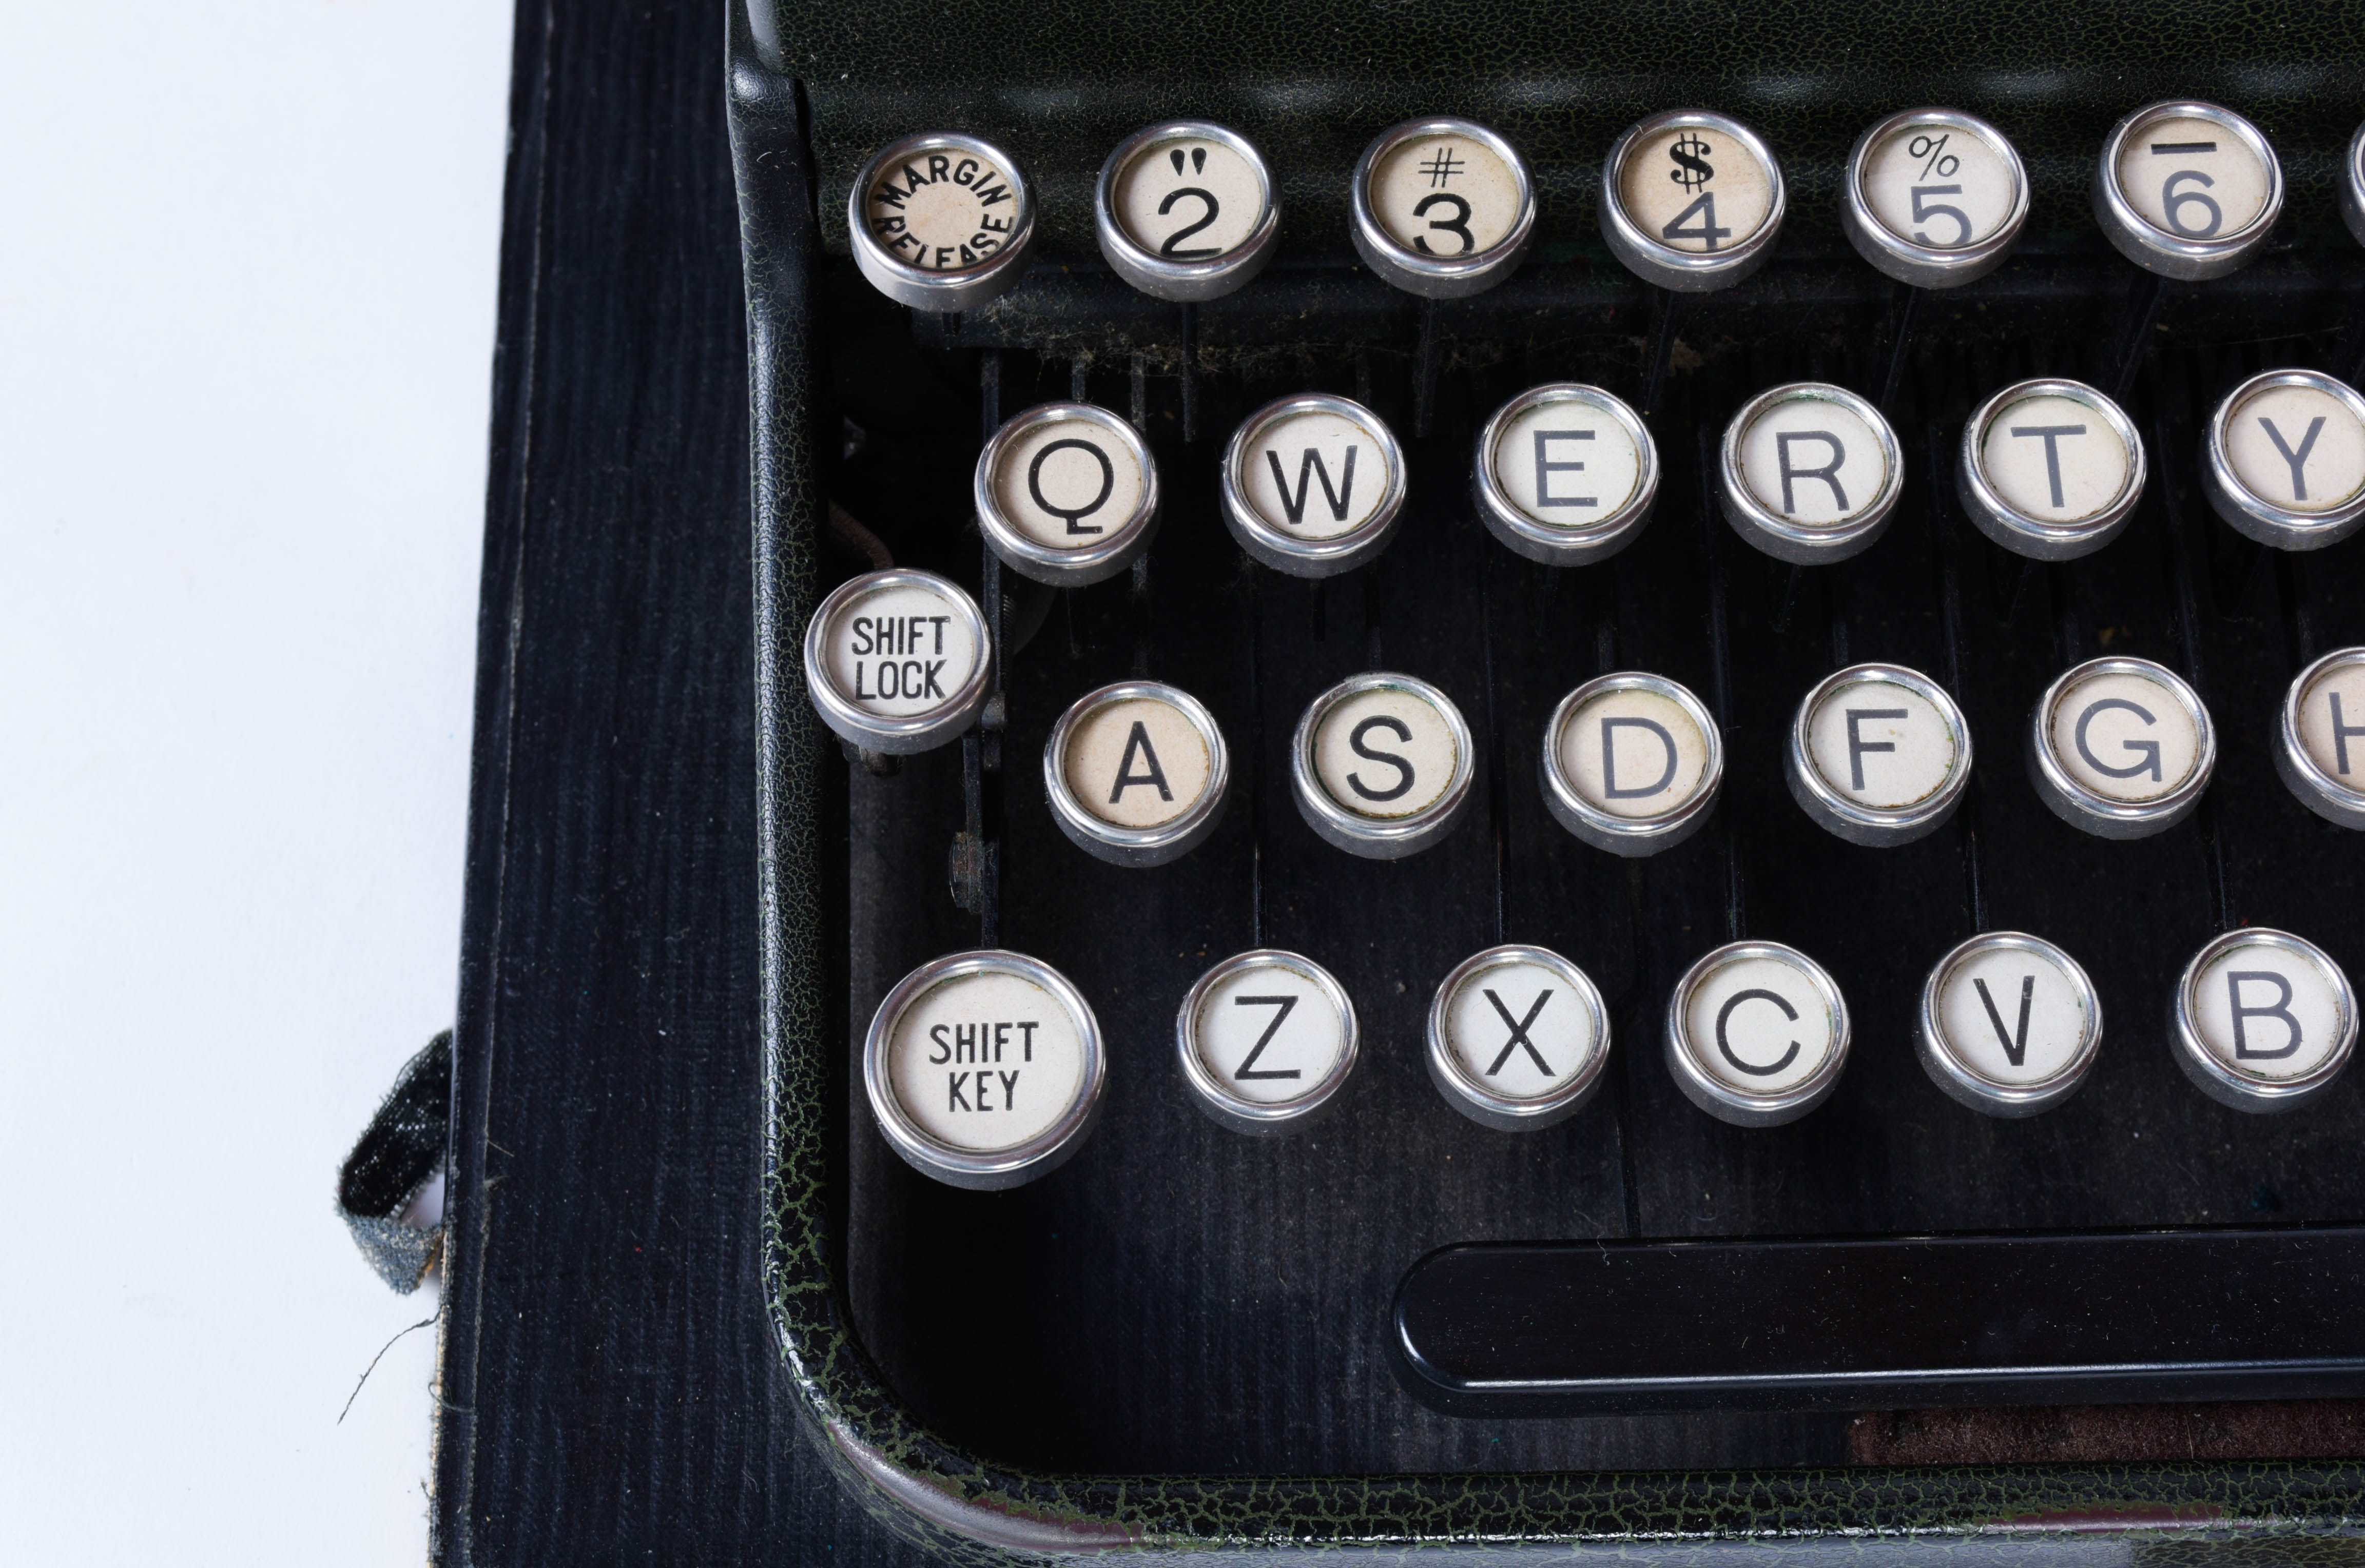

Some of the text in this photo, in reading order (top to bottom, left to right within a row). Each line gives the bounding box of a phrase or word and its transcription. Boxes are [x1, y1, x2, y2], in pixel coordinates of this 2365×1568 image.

[876, 155, 1011, 209] MARGIN
[1419, 148, 1465, 188] #
[1670, 133, 1714, 193] $
[1909, 134, 1960, 181] %
[1158, 188, 1222, 257] 2
[1413, 193, 1474, 254] 3
[1662, 191, 1732, 249] 4
[1910, 185, 1972, 246] 5
[2161, 170, 2222, 238] 6
[1028, 439, 1114, 535] Q
[1266, 446, 1357, 524] W
[1534, 430, 1597, 507] E
[1777, 431, 1849, 514] R
[2011, 426, 2086, 507] T
[2258, 417, 2324, 500] Y
[852, 616, 950, 655] SHIFT
[855, 660, 946, 700] LOCK
[1109, 721, 1174, 803] A
[1347, 715, 1414, 801] S
[1601, 718, 1677, 798] D
[1846, 709, 1908, 790] F
[2076, 699, 2161, 781] G
[929, 1022, 1039, 1064] SHIFT
[1234, 996, 1301, 1080] Z
[1483, 990, 1556, 1076] X
[1716, 989, 1800, 1076] C
[1973, 976, 2034, 1066] V
[2228, 972, 2302, 1060] B
[949, 1070, 1019, 1112] KEY
